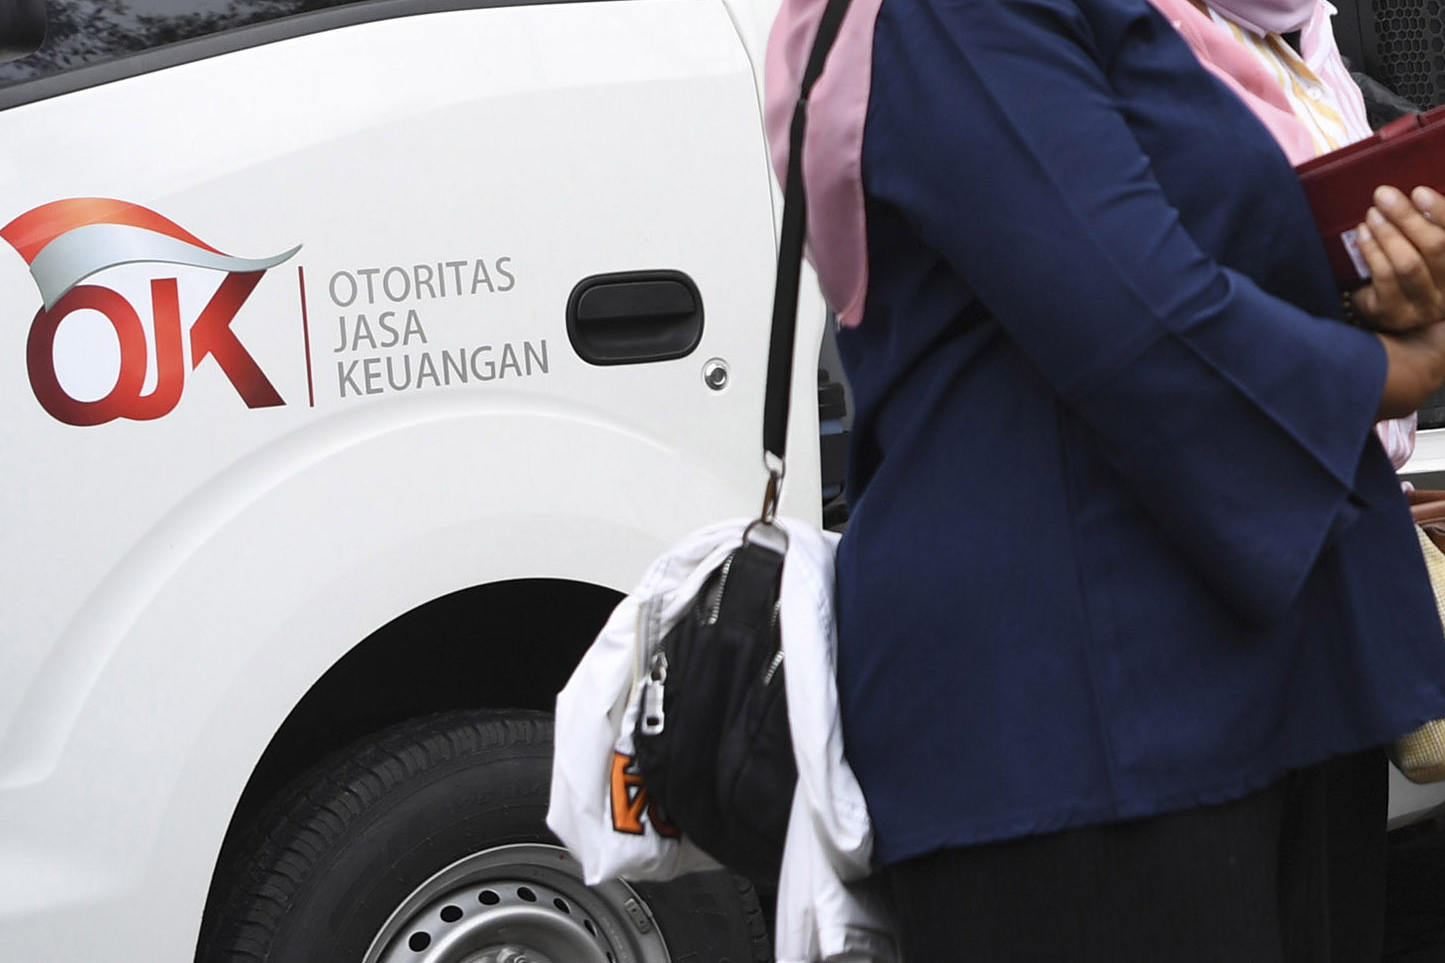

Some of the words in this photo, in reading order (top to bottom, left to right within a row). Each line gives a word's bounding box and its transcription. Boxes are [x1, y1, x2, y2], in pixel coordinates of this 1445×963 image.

[329, 256, 516, 308] OTORITAS
[26, 269, 287, 427] OJK
[334, 310, 428, 353] JASA
[337, 340, 550, 398] KEUANGAN
